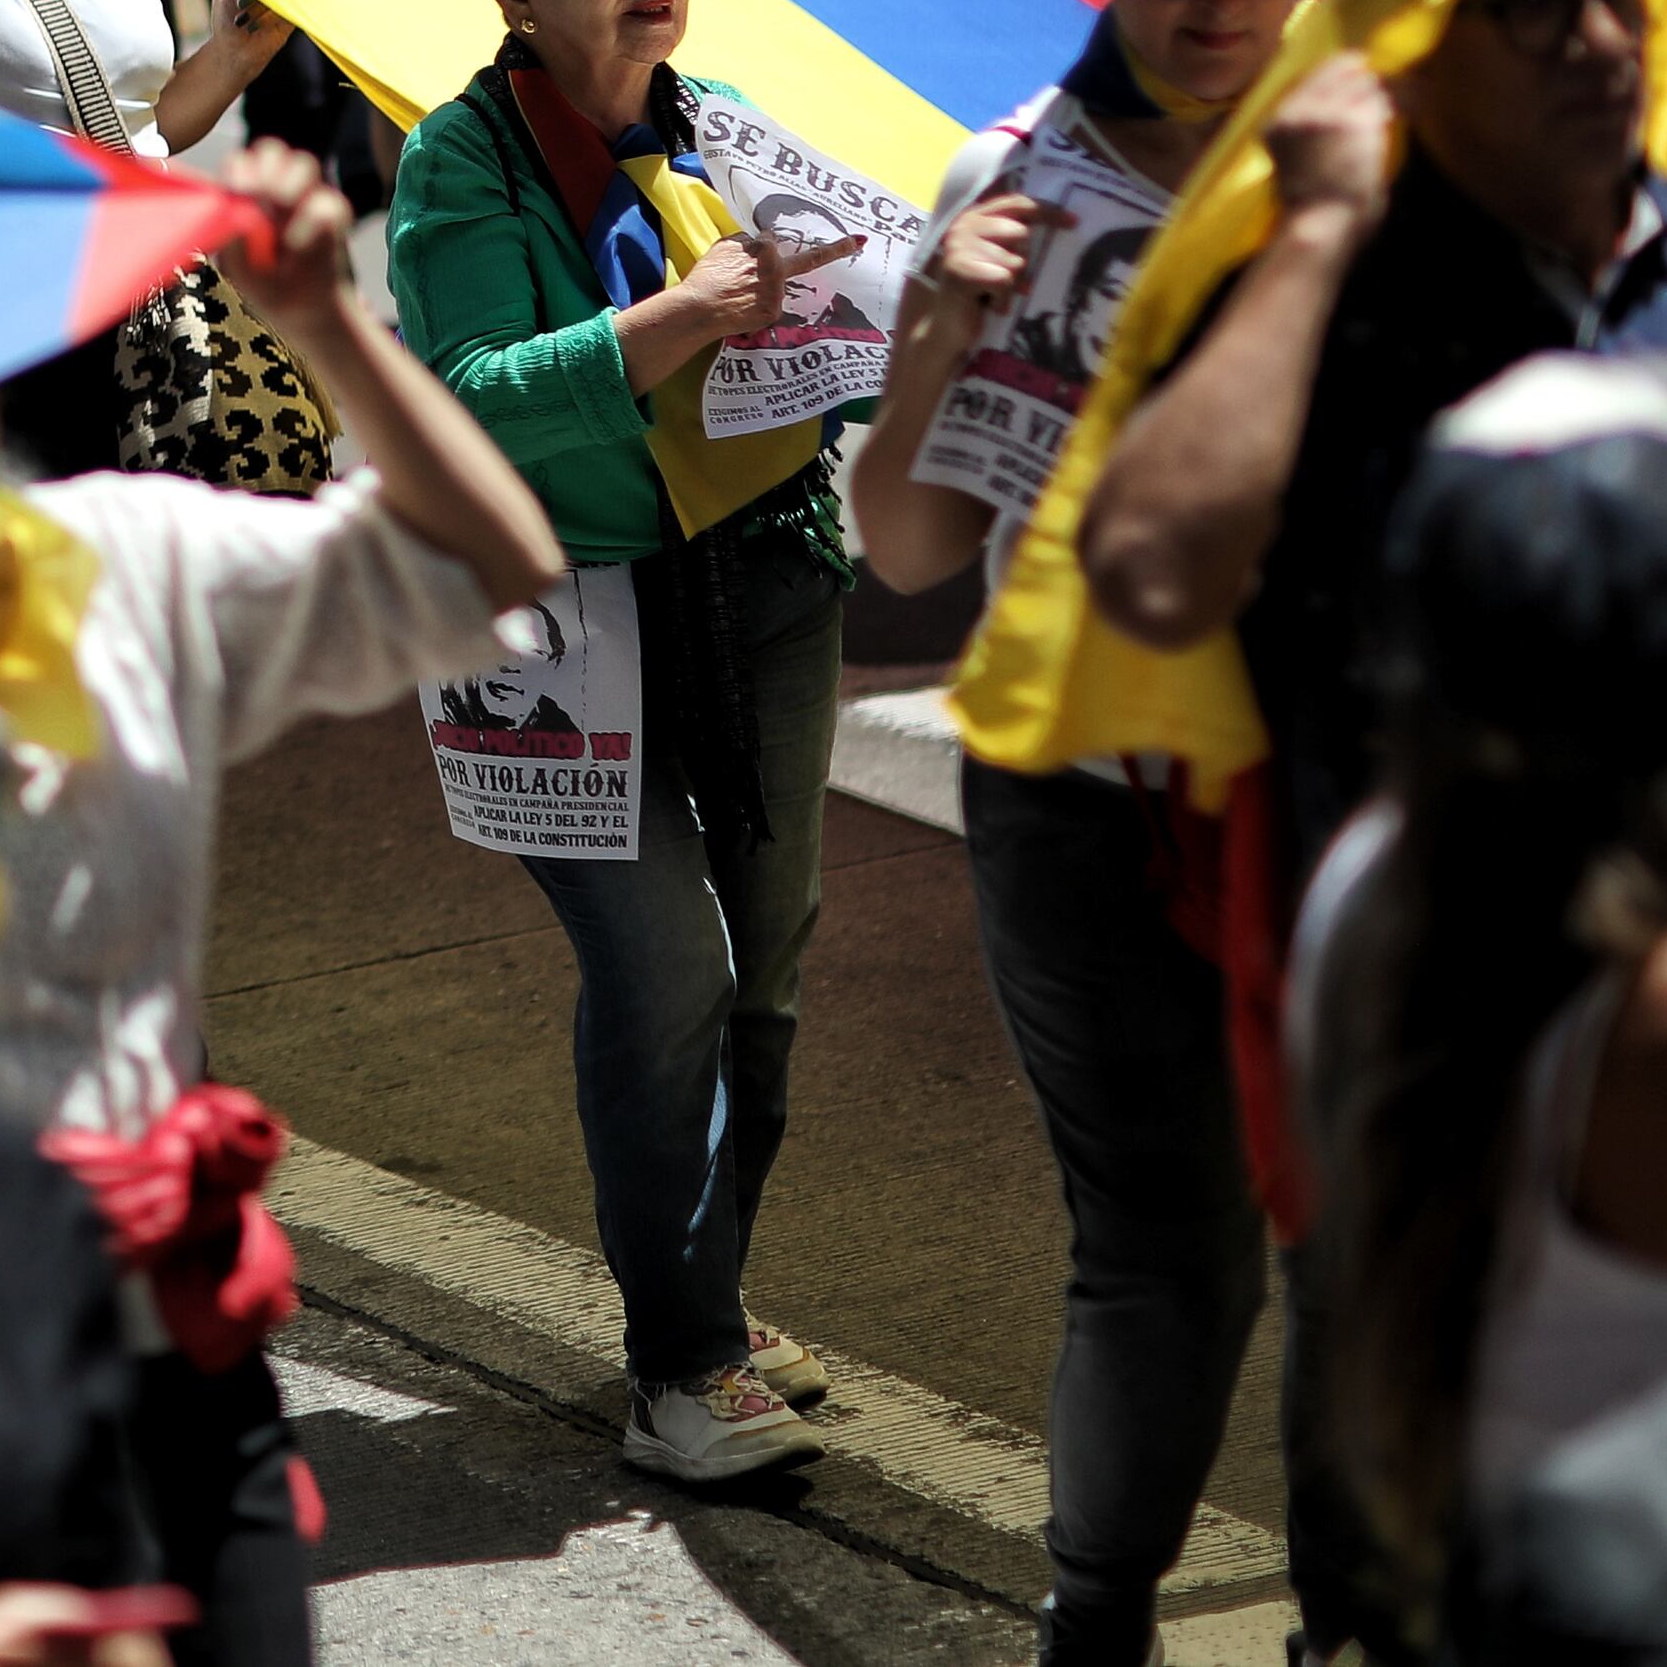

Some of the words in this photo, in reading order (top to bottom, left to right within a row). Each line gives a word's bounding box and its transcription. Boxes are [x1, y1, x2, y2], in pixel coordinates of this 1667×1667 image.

[703, 110, 767, 157] SE
[771, 142, 925, 235] BUSCA
[765, 381, 821, 407] APLICAR
[821, 373, 840, 387] LA
[840, 369, 865, 380] LEY
[771, 404, 801, 420] ART.
[801, 394, 824, 410] 109
[824, 385, 844, 400] DE
[844, 381, 864, 392] LA
[436, 753, 471, 788] POR
[473, 762, 629, 799] VIOLACIÓN
[474, 805, 507, 823] APLICAR
[509, 810, 522, 825] LA
[524, 812, 542, 826] LEY
[545, 813, 553, 825] 5
[555, 814, 578, 827] DEL
[581, 814, 598, 827] 92
[600, 815, 609, 828] Y
[613, 816, 629, 828] EL
[519, 797, 560, 811] CAMPAÑA
[561, 800, 630, 812] PRESIDENCIAL
[493, 826, 507, 841] 109
[509, 829, 522, 843] DE
[524, 831, 537, 845] LA
